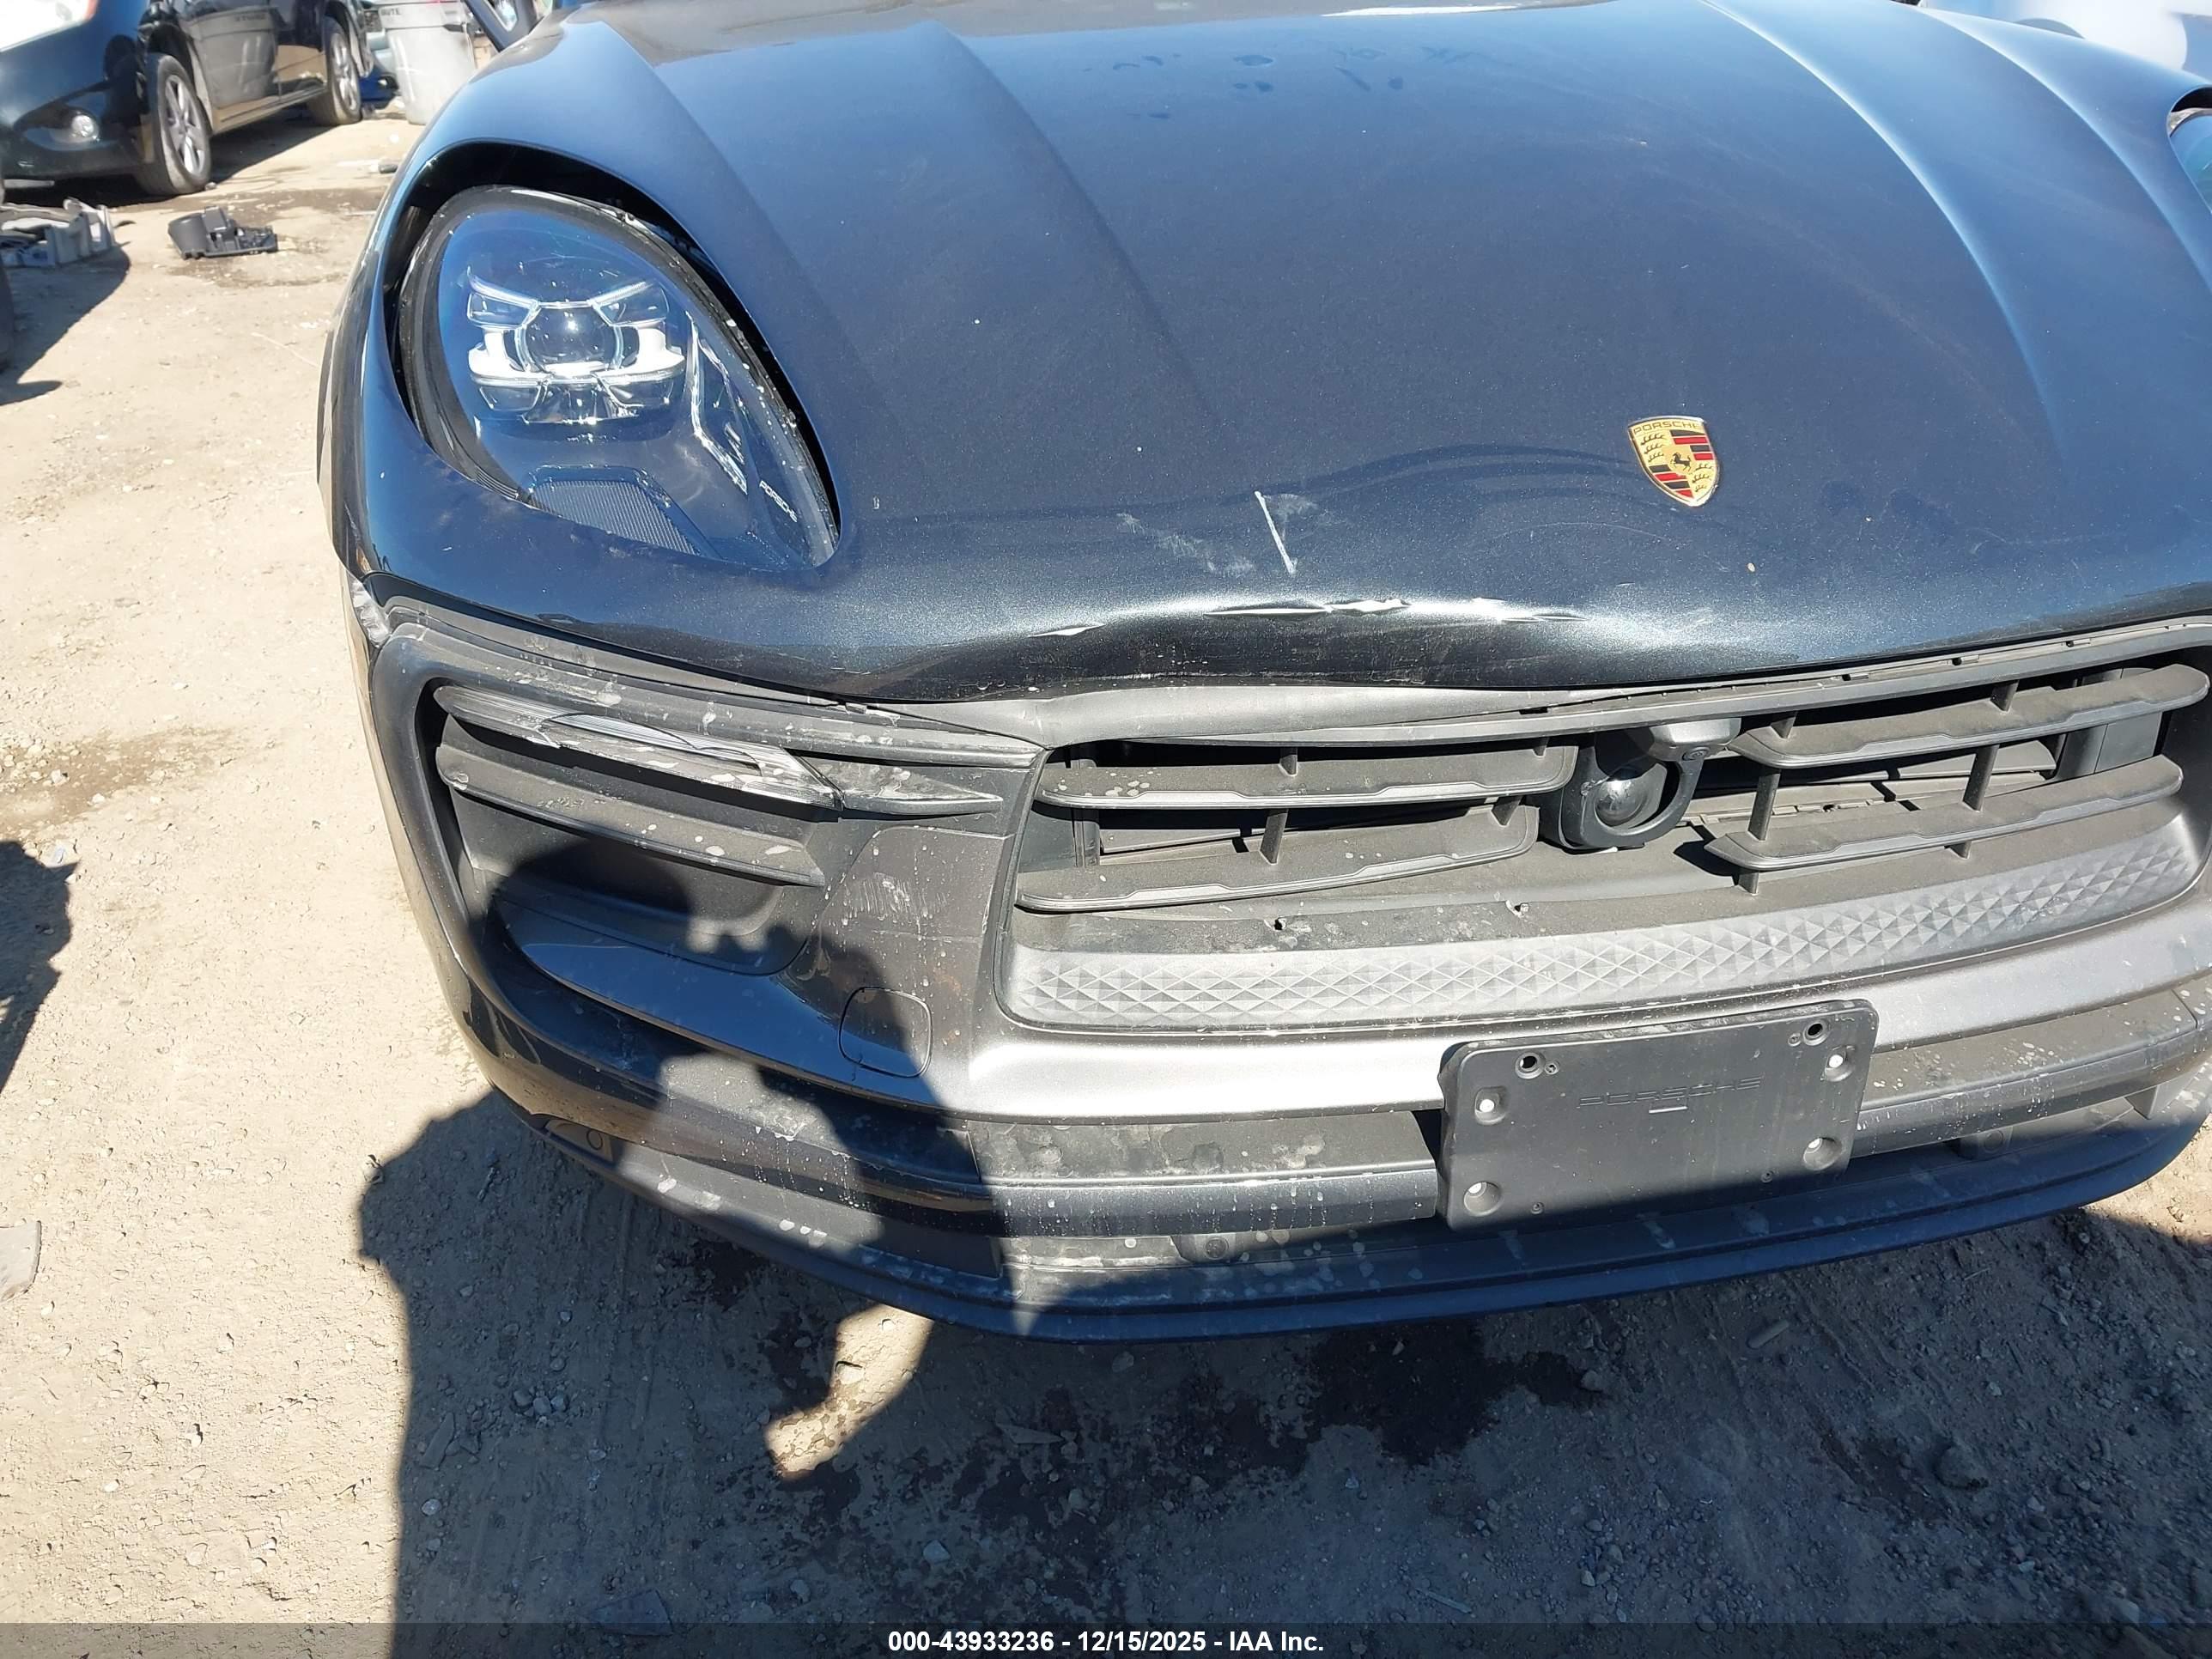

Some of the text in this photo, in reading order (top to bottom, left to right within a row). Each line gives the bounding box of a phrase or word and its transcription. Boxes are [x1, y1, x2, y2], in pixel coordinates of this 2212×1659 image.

[1633, 421, 1702, 434] PORSCHE
[759, 480, 797, 522] PORSCHE
[1577, 1077, 1763, 1108] PORSCHE
